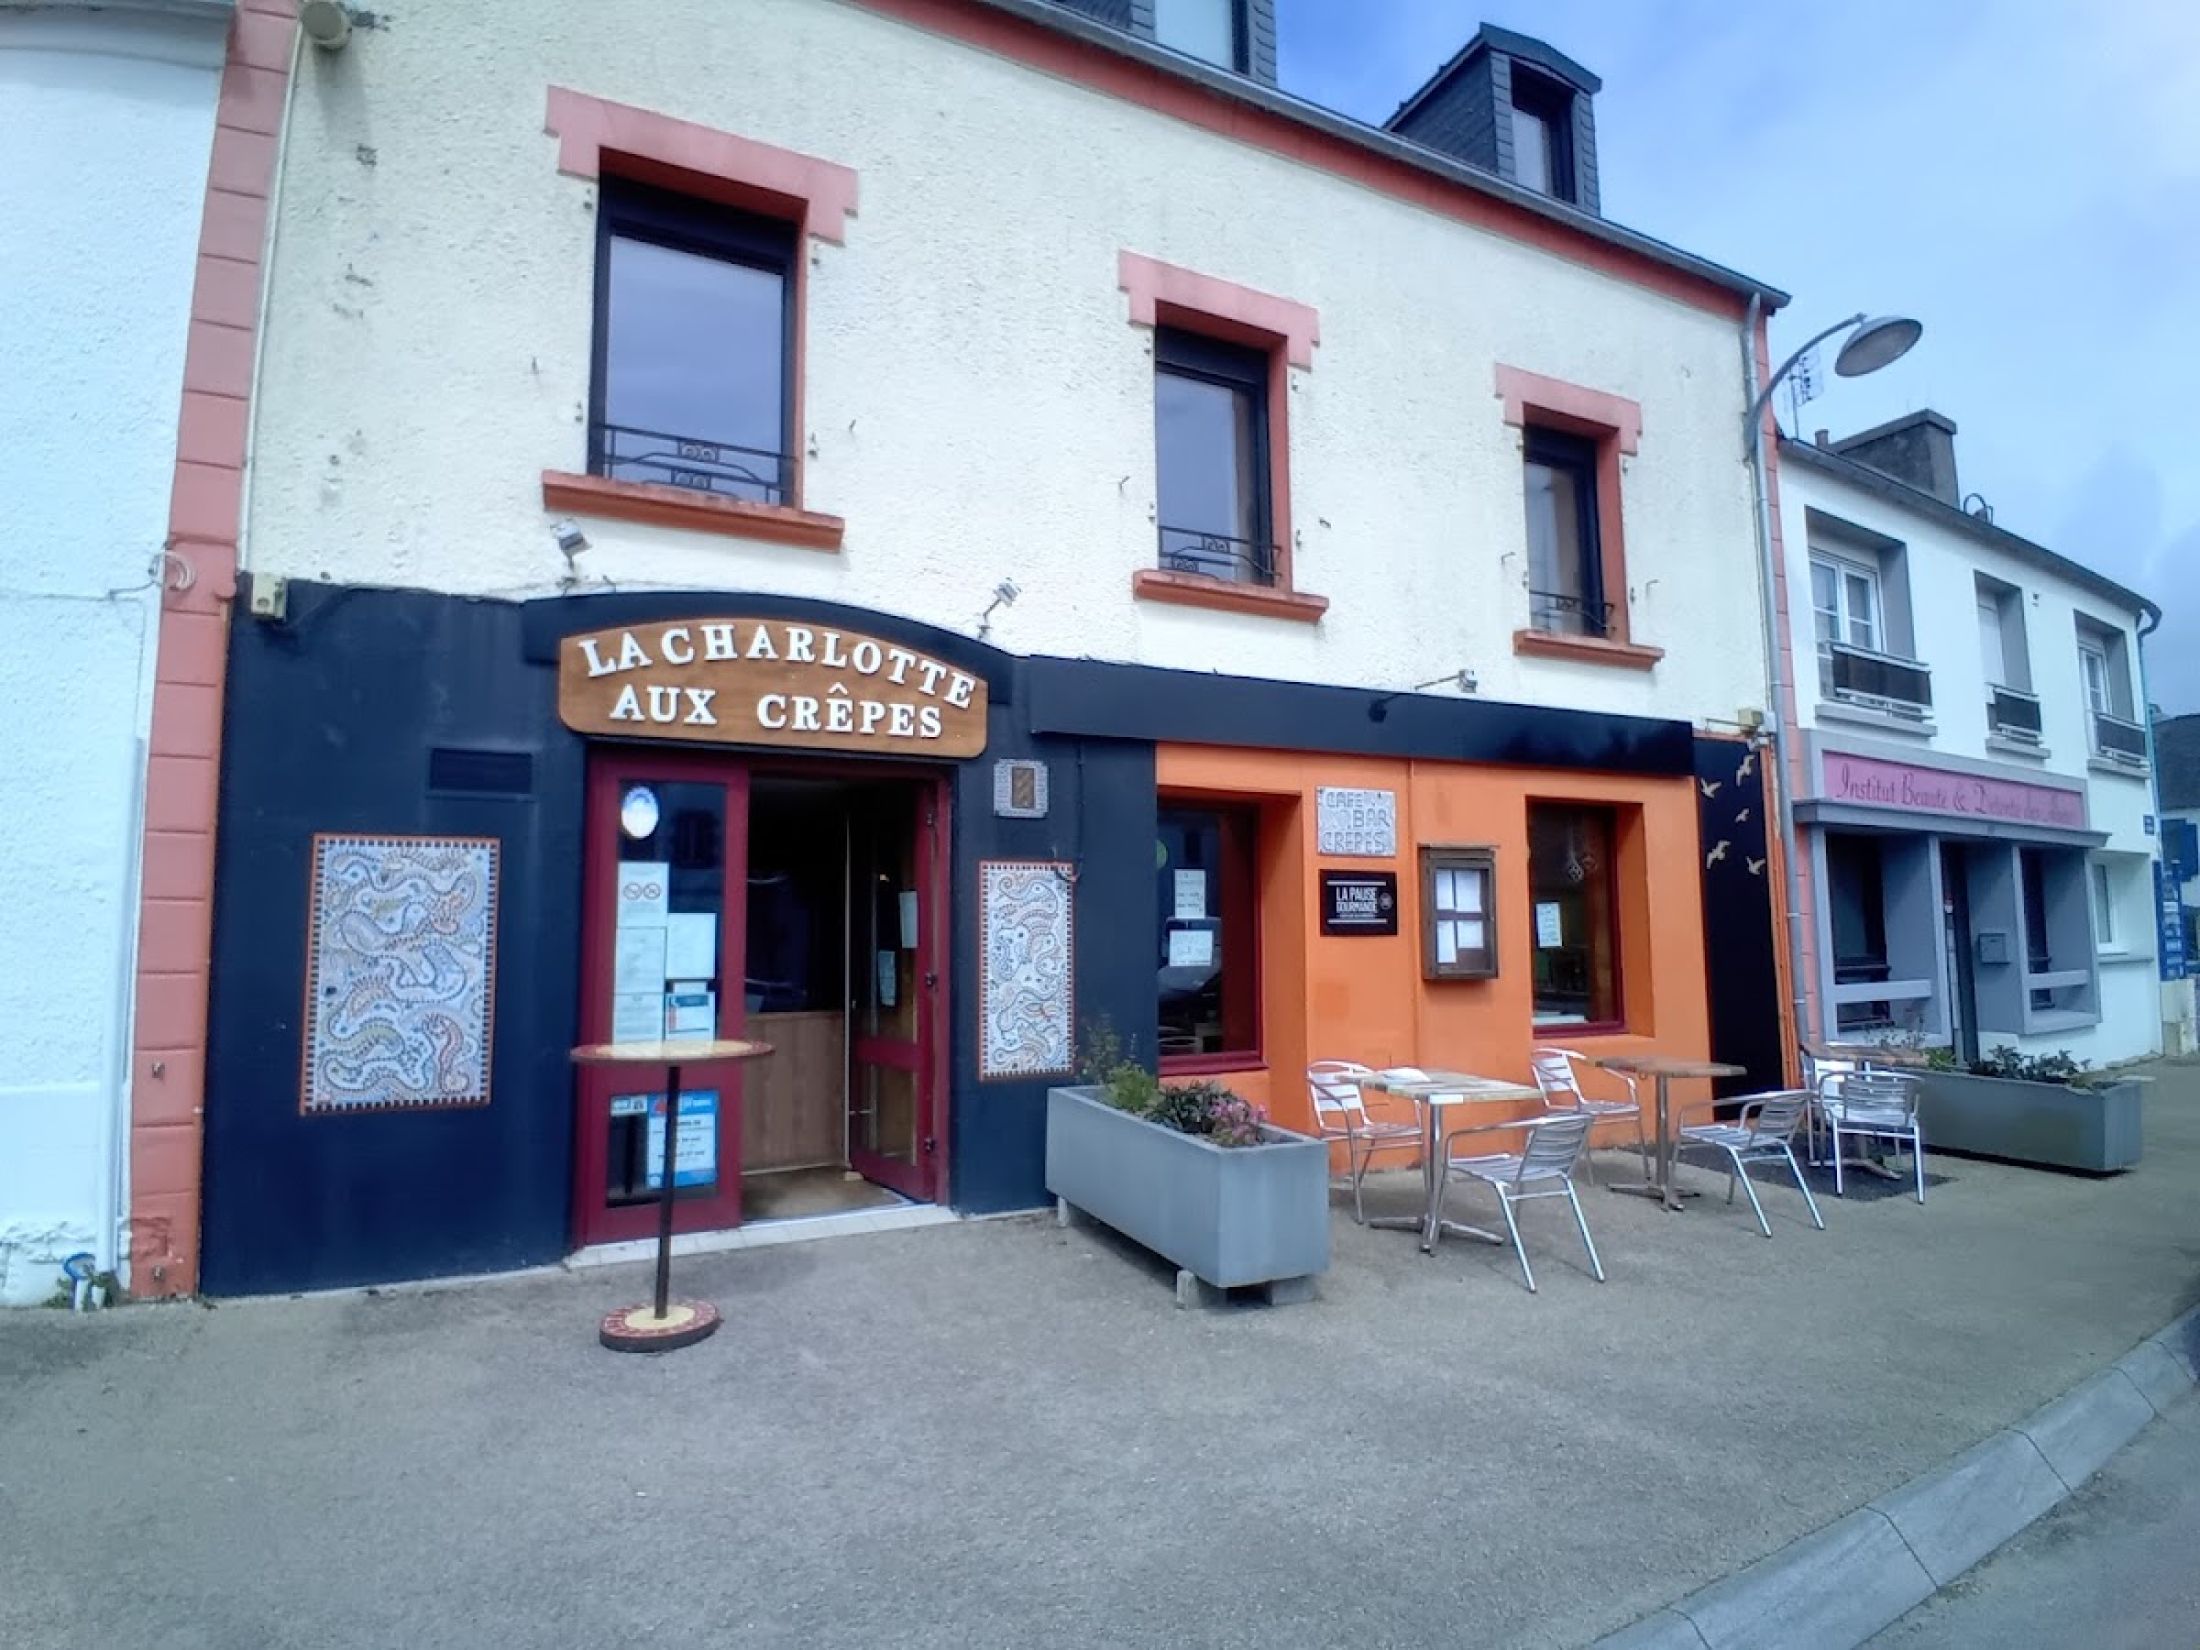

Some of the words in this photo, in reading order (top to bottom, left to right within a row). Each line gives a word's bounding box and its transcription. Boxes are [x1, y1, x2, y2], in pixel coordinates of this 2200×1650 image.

[579, 631, 653, 677] LA
[661, 624, 976, 709] CHARLOTTE
[609, 684, 718, 726] AUX
[756, 682, 942, 739] CRÊPES
[1835, 763, 1896, 804] Institut
[1352, 807, 1391, 828] BAR
